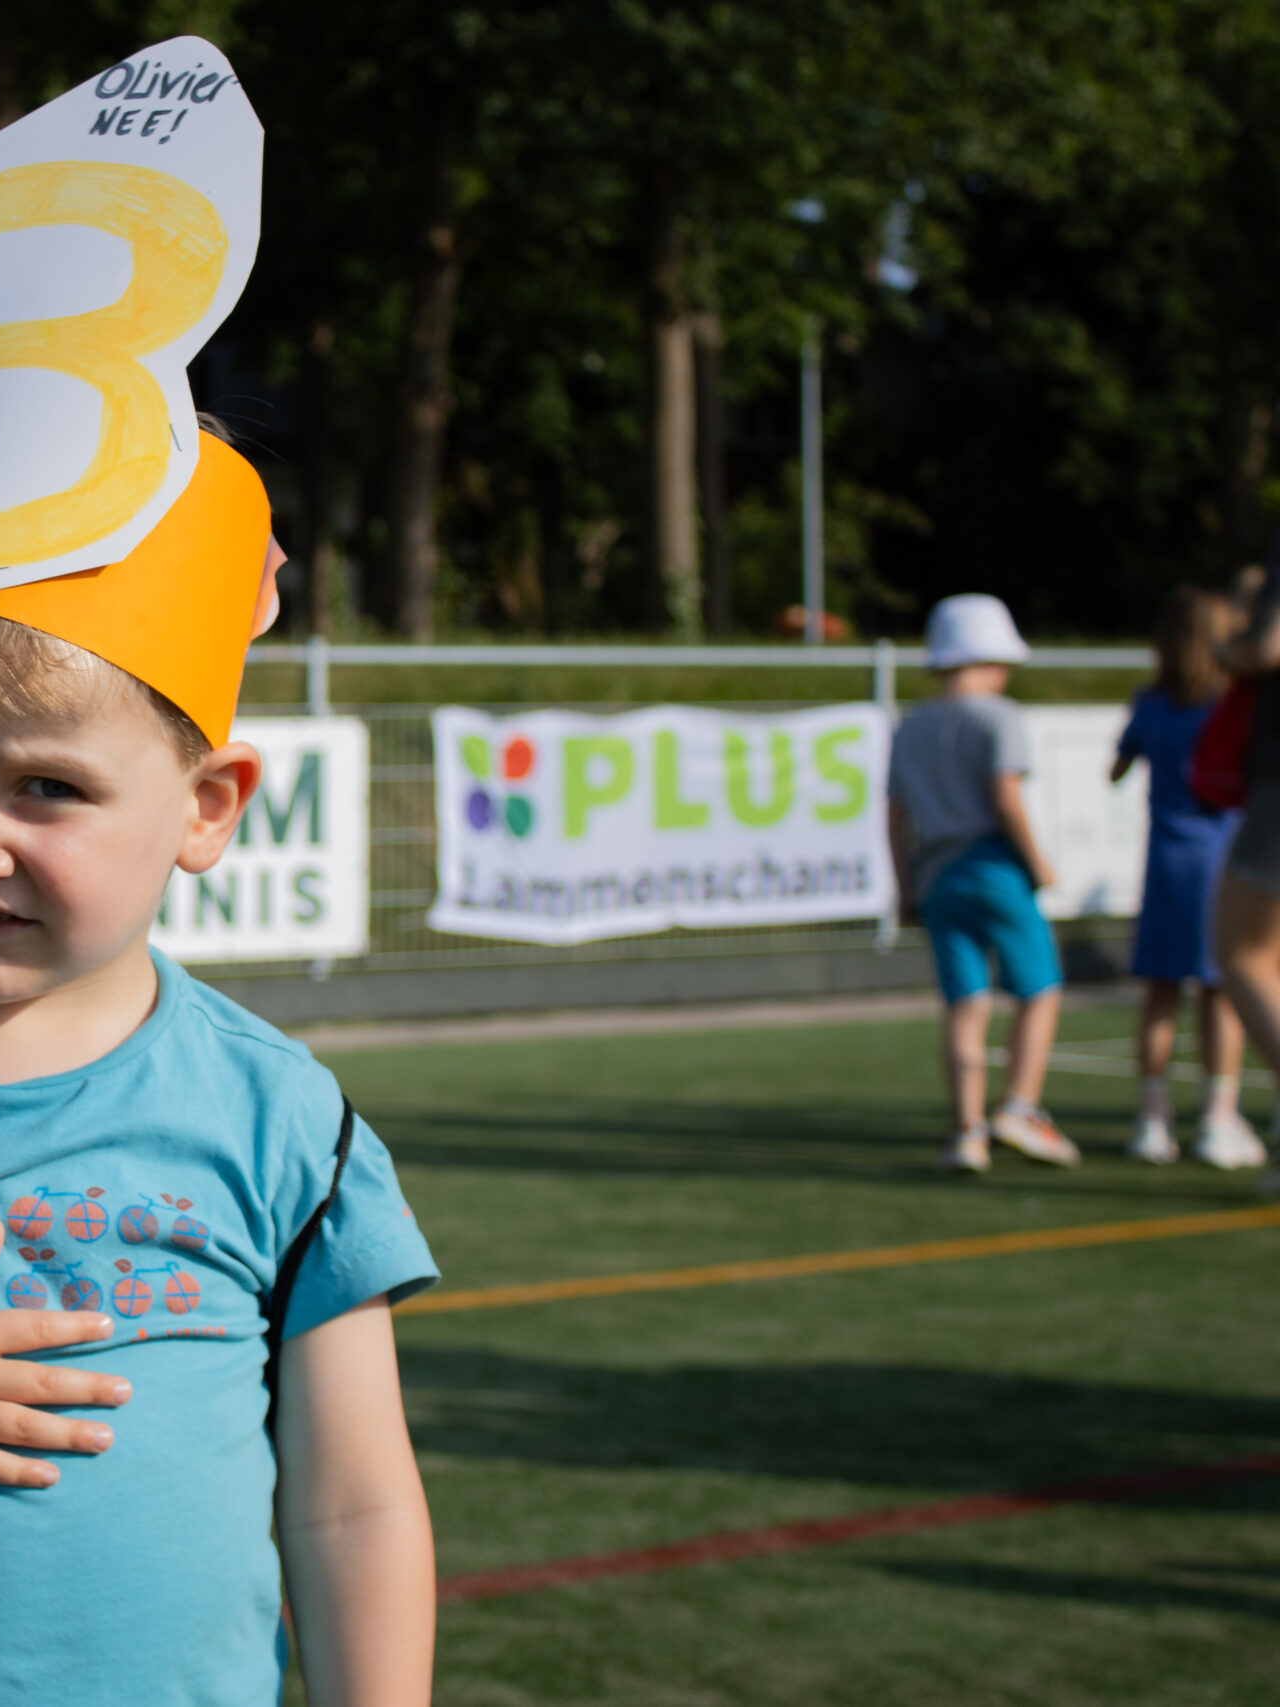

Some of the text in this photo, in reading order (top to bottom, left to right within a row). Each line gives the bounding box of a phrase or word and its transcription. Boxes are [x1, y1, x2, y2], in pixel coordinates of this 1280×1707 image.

[88, 105, 188, 144] NEE!
[562, 728, 869, 840] PLUS
[460, 850, 870, 917] Lammenschans
